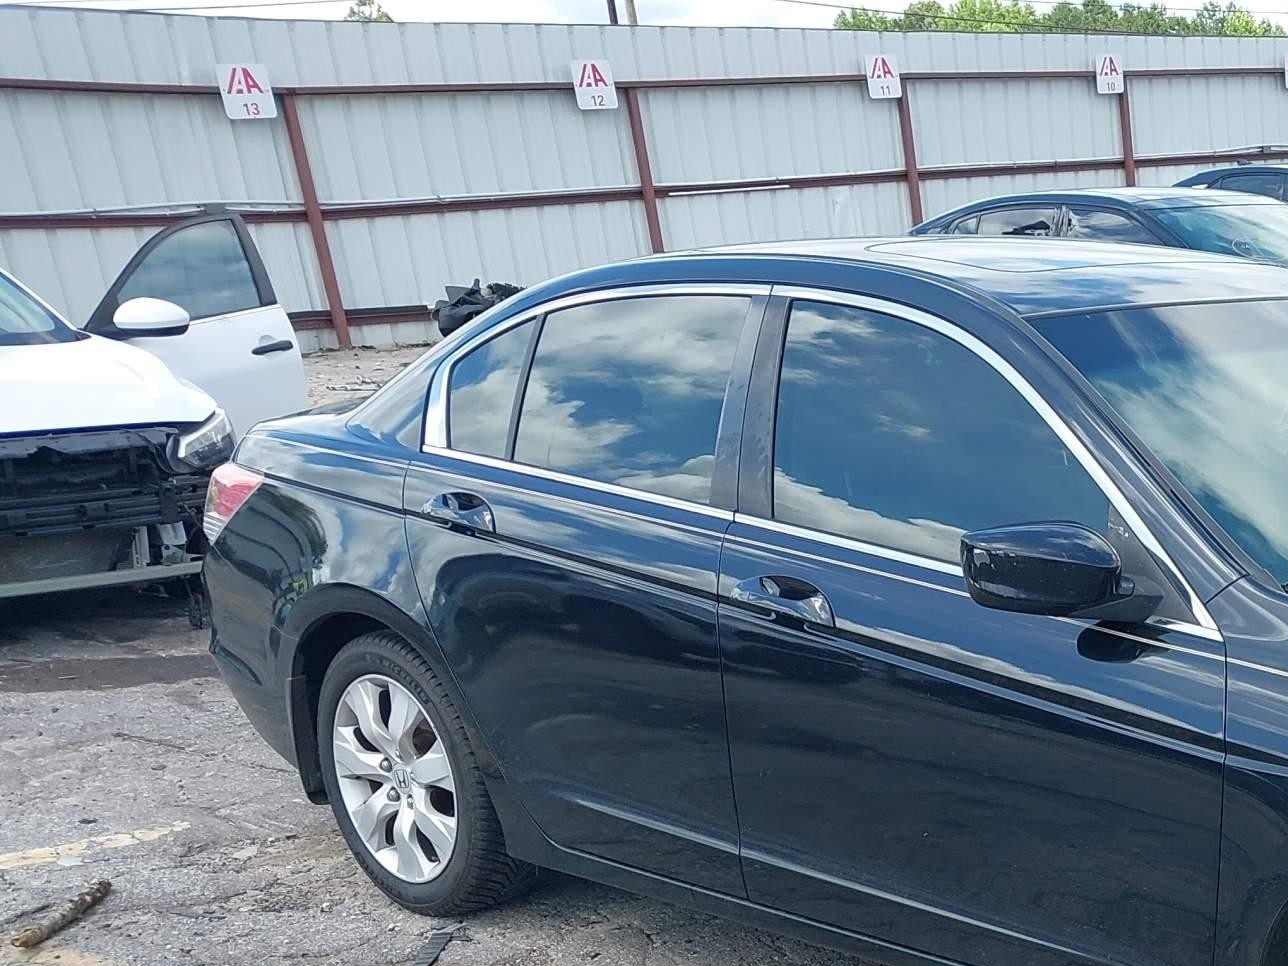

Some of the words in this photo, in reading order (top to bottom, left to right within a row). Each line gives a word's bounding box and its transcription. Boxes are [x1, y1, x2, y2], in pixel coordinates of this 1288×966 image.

[880, 85, 891, 97] 11
[1106, 82, 1116, 92] 10
[590, 95, 606, 107] 12
[242, 103, 260, 116] 13
